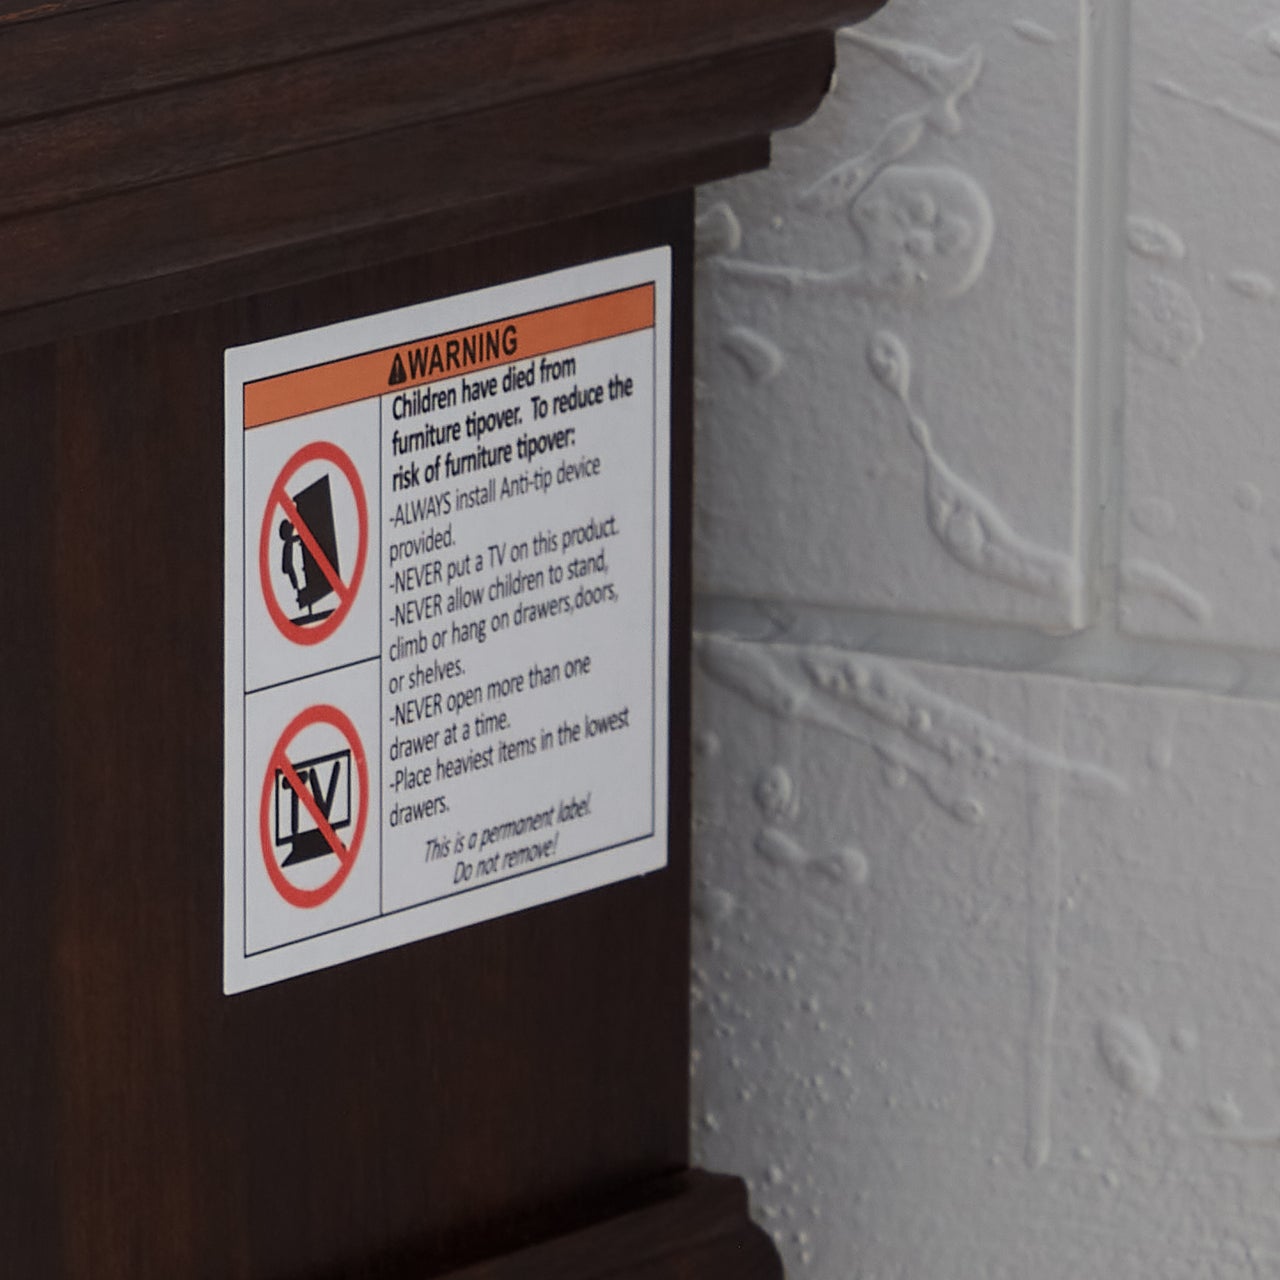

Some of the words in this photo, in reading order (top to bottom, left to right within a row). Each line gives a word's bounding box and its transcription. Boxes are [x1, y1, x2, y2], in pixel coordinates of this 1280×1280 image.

[407, 325, 519, 380] WARNING
[392, 387, 457, 420] Children
[461, 376, 497, 404] have
[502, 361, 535, 393] died
[540, 357, 576, 382] from
[392, 422, 461, 456] furniture
[466, 406, 523, 440] tipover.
[530, 395, 549, 421] To
[552, 385, 604, 415] reduce
[608, 373, 634, 400] the
[392, 462, 420, 492] risk
[424, 455, 443, 483] of
[444, 442, 512, 475] furniture
[516, 427, 576, 463] tipover:
[389, 490, 452, 528] -ALWAYS
[455, 479, 497, 513] install
[499, 467, 552, 501] Anti-tip
[556, 455, 602, 485] device
[389, 522, 456, 567] provided.
[389, 559, 443, 594] -NEVER
[446, 553, 472, 586] put
[474, 553, 484, 573] a
[487, 542, 507, 569] TV
[510, 539, 529, 562] on
[532, 529, 558, 557] this
[561, 514, 621, 554] product.
[389, 593, 443, 628] -NEVER
[446, 585, 485, 615] allow
[488, 568, 545, 602] children
[548, 563, 564, 585] to
[567, 548, 609, 581] stand,
[389, 629, 428, 662] climb
[431, 628, 448, 650] or
[451, 618, 487, 645] hang
[490, 610, 510, 633] on
[389, 674, 406, 695] or
[408, 657, 466, 690] shelves.
[389, 692, 443, 728] -NEVER
[446, 683, 483, 718] open
[486, 674, 525, 702] more
[528, 662, 561, 690] than
[563, 654, 592, 680] one
[389, 728, 441, 763] drawer
[443, 722, 458, 747] at
[461, 721, 471, 741] a
[474, 710, 512, 739] time.
[389, 765, 433, 794] -Place
[435, 745, 495, 782] heaviest
[497, 734, 538, 764] items
[540, 727, 554, 753] in
[557, 719, 581, 748] the
[583, 705, 631, 740] lowest
[389, 793, 450, 828] drawers.
[424, 836, 450, 864] This
[454, 830, 466, 854] is
[467, 831, 478, 851] a
[479, 804, 556, 853] permanent
[452, 860, 474, 885] Do
[475, 852, 501, 879] not
[501, 830, 560, 869] remove!
